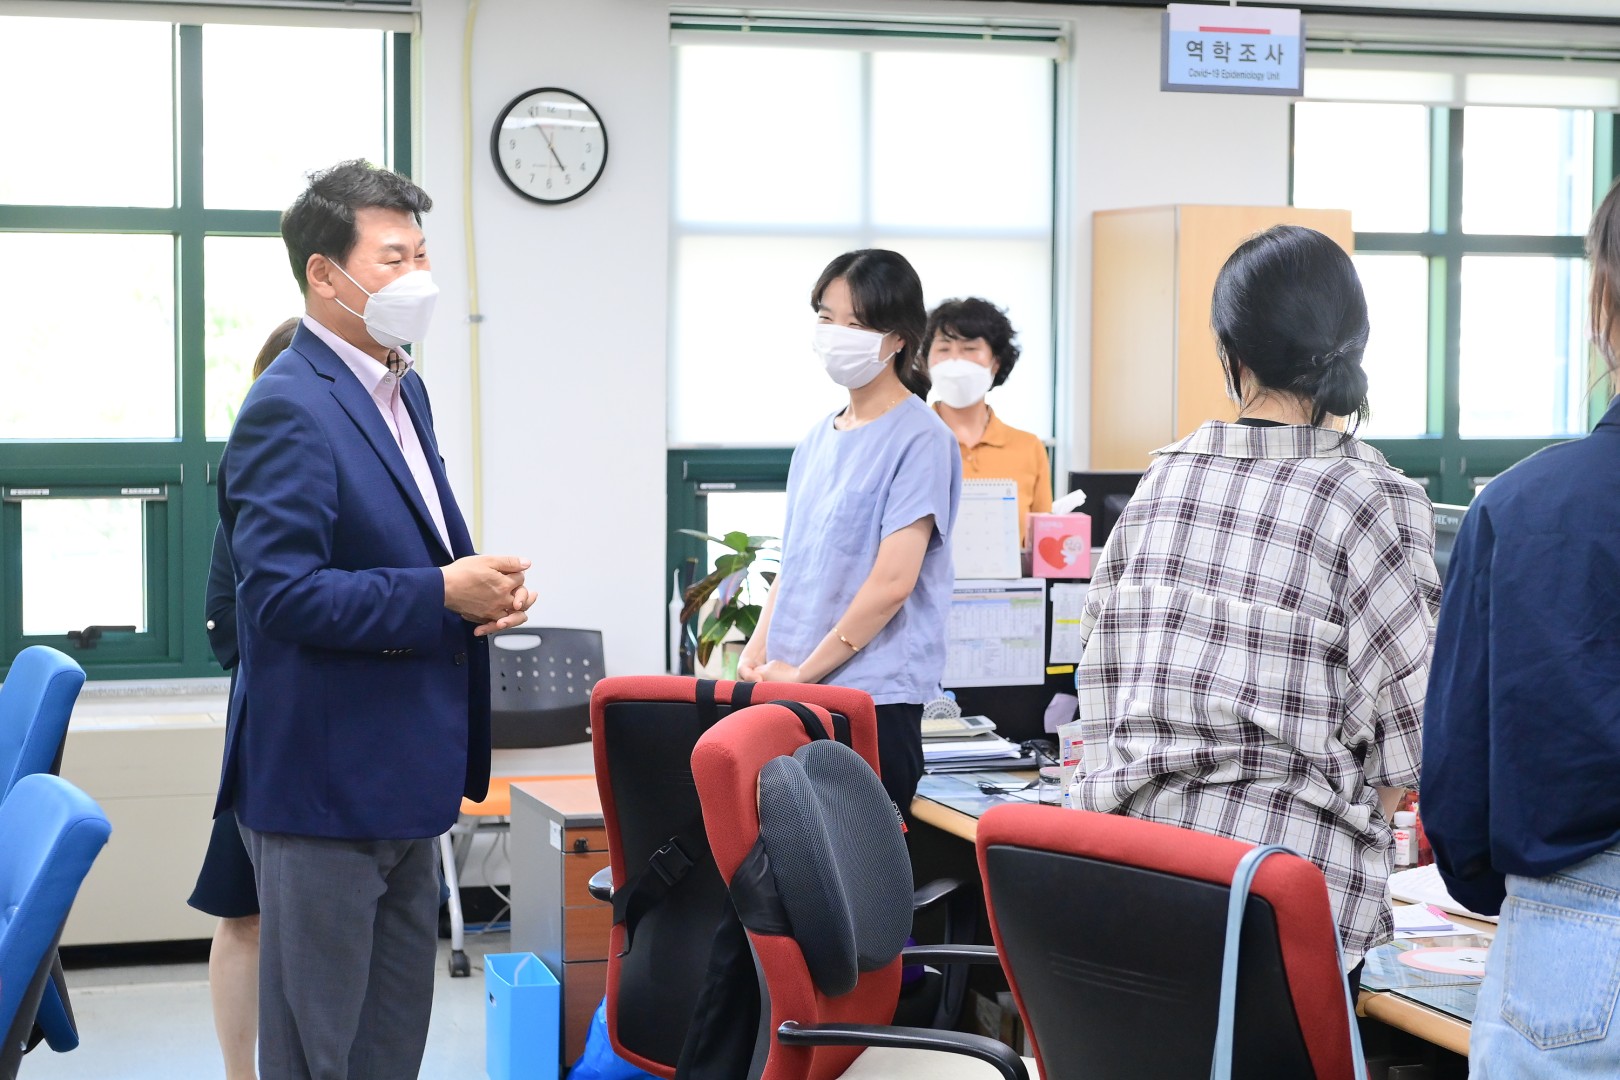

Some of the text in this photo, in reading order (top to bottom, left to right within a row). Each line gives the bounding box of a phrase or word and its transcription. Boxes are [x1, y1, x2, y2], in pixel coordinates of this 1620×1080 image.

[1186, 40, 1284, 65] 역학조사
[1188, 68, 1280, 81] Covid-19 Epidemiology Unit
[509, 139, 516, 150] 9
[586, 143, 592, 153] 3
[515, 158, 521, 169] 8
[580, 162, 586, 171] 4
[546, 178, 552, 189] 6
[565, 174, 571, 185] 5
